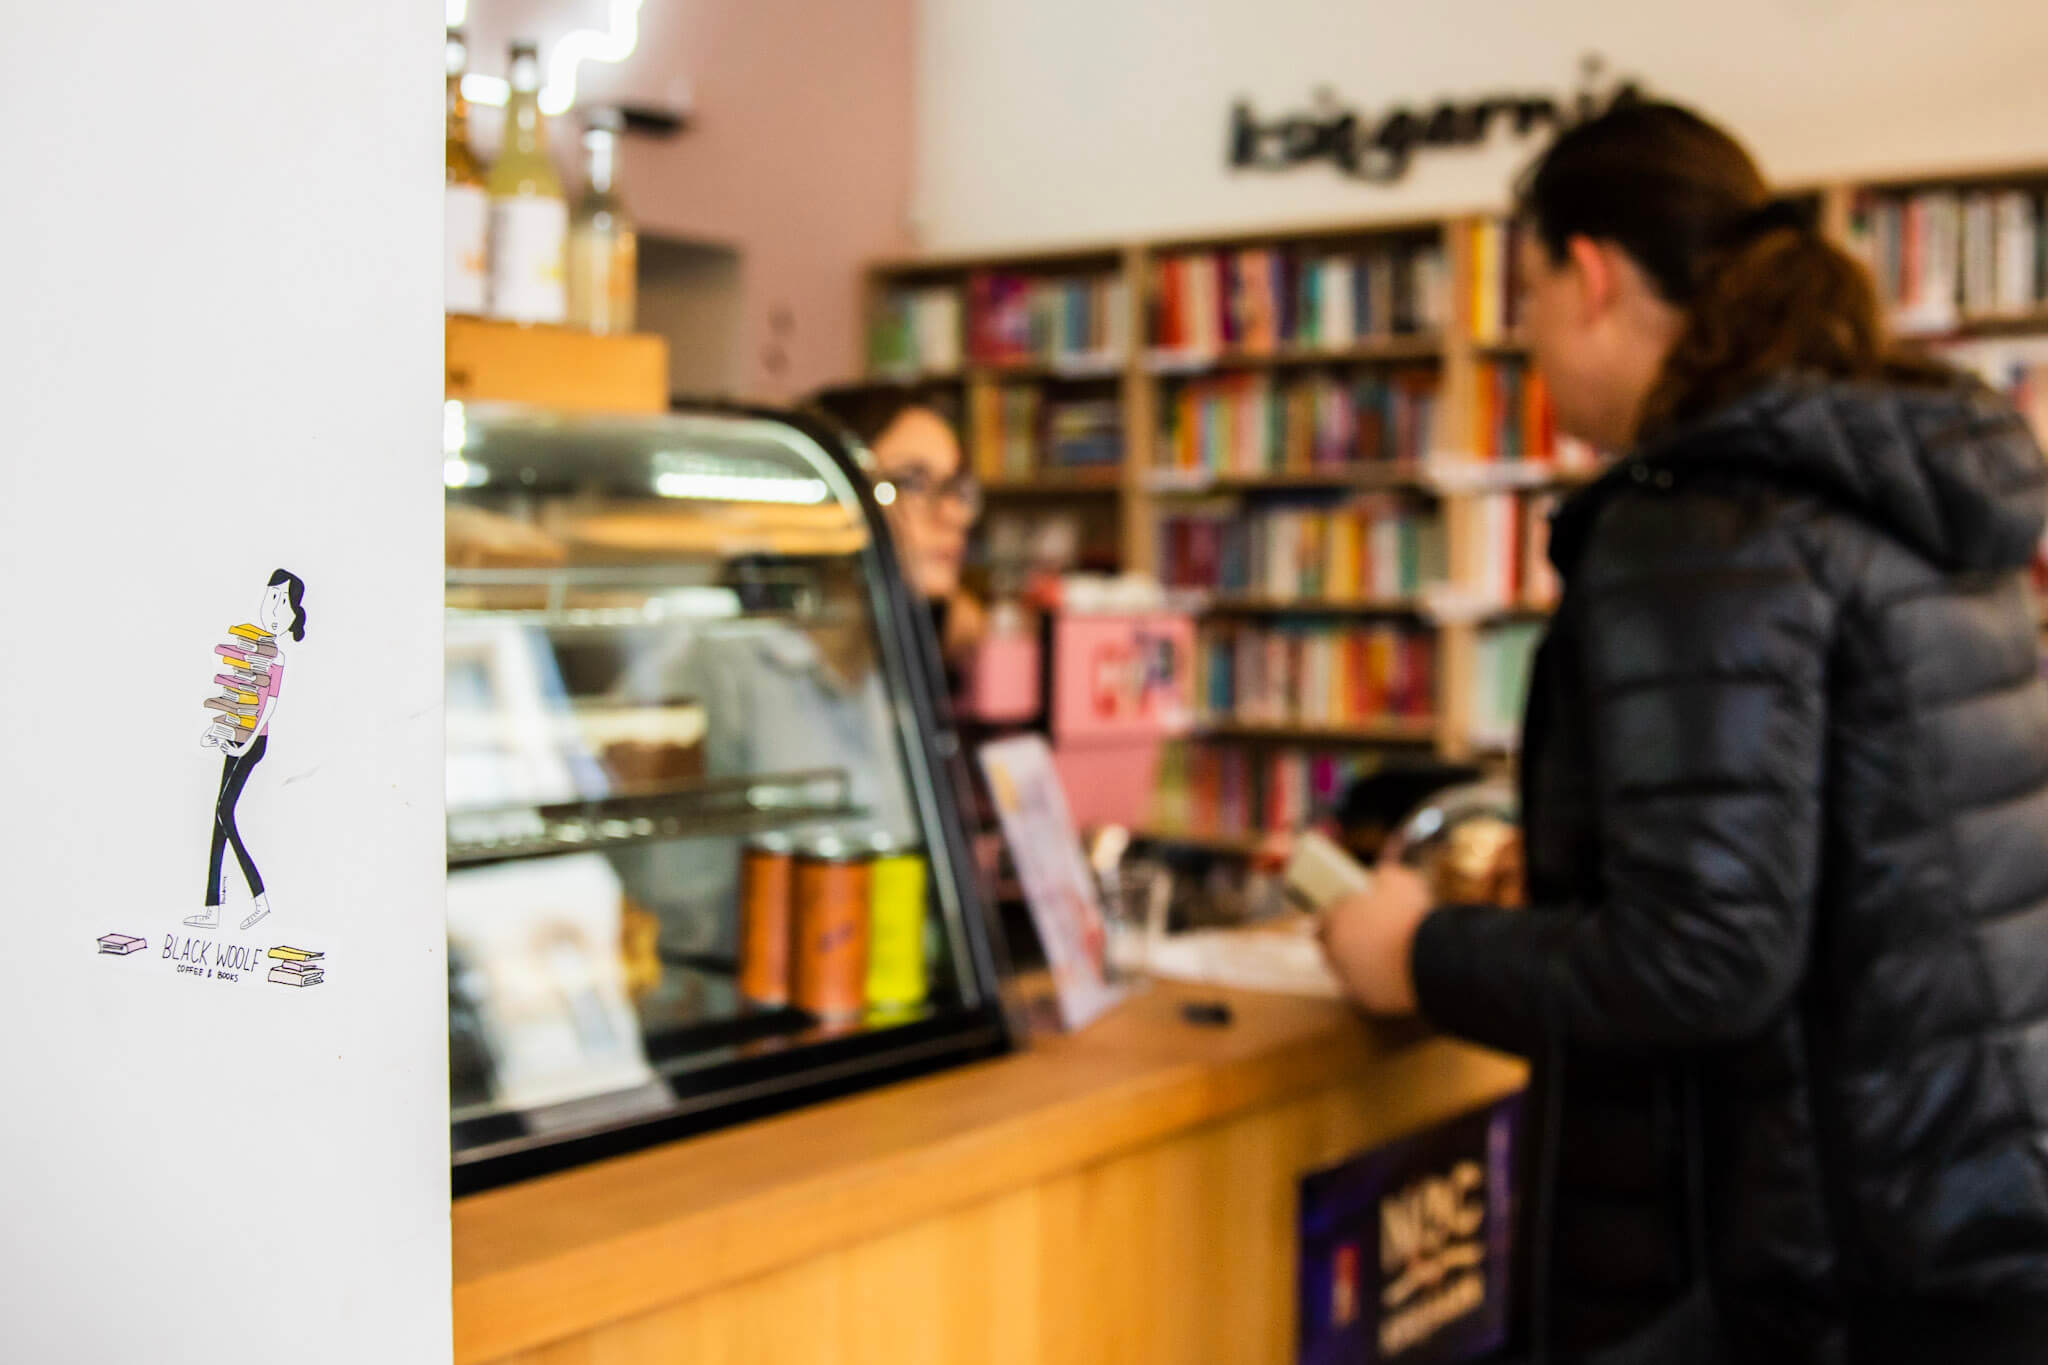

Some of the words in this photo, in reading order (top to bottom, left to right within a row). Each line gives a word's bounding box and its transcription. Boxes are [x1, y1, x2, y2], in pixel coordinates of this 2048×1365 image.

[162, 933, 212, 966] BLACK
[216, 943, 263, 972] WOOLF
[176, 965, 204, 977] COFFEE
[217, 971, 239, 983] BOOKS
